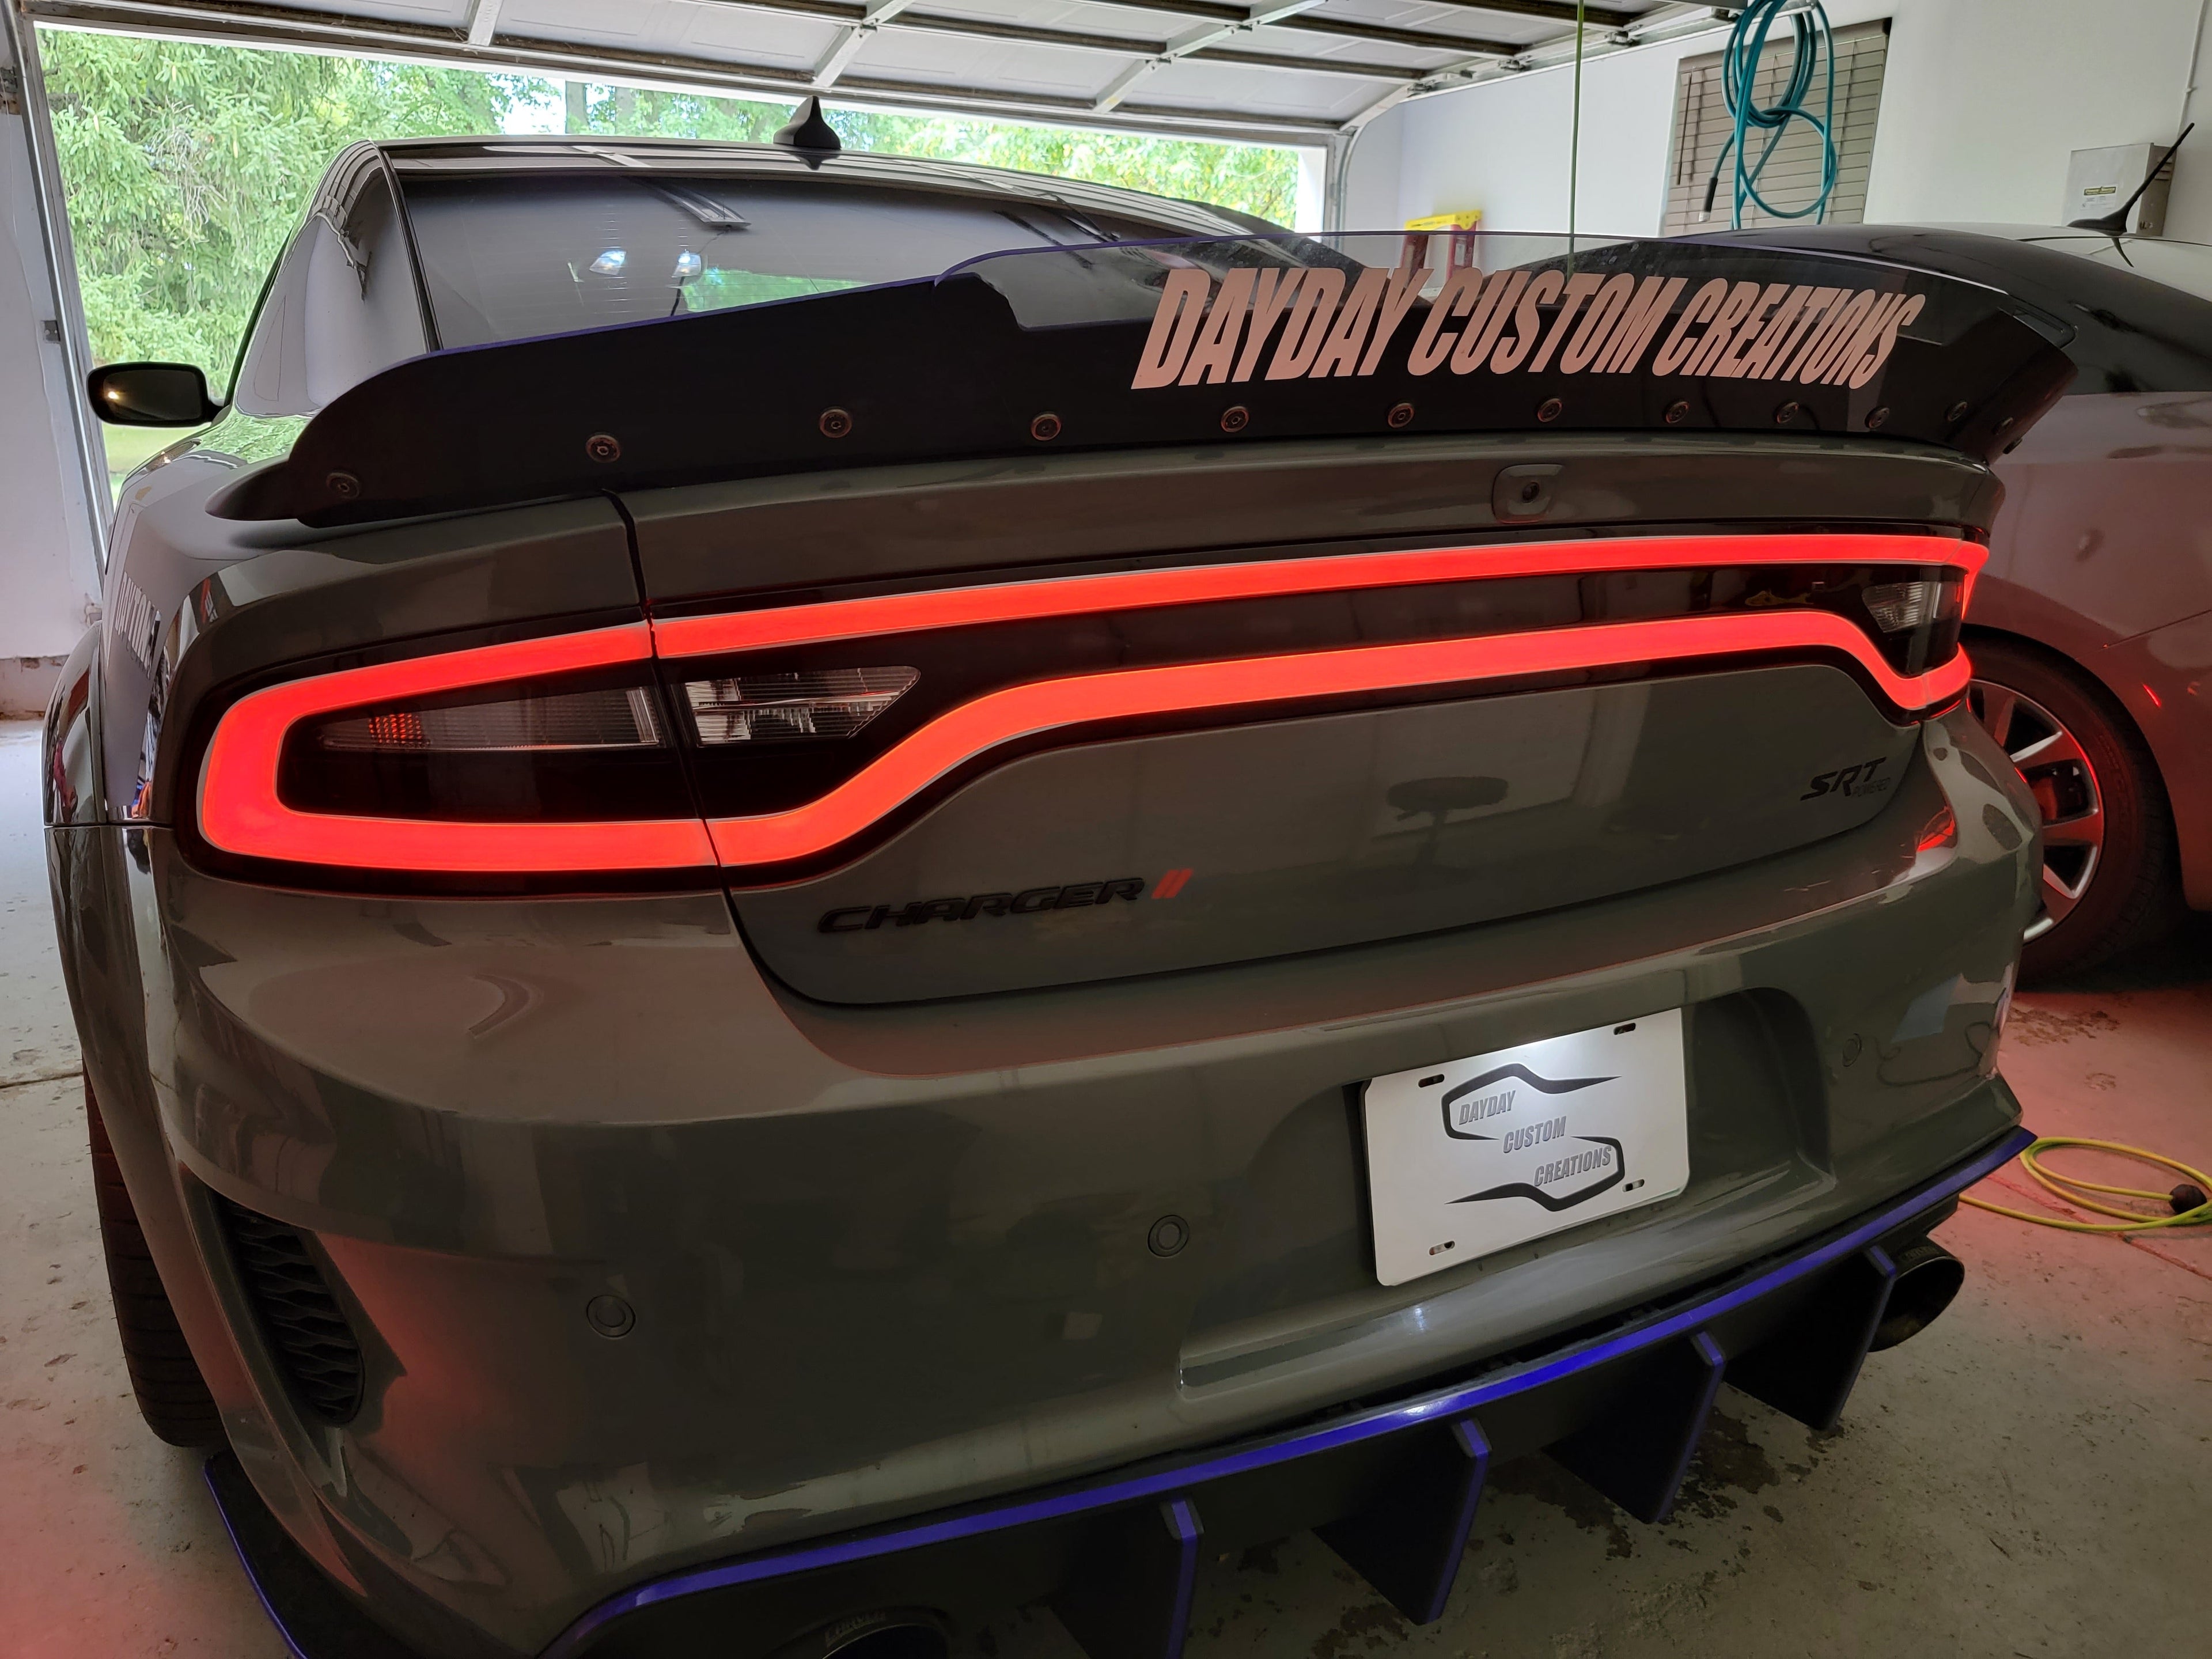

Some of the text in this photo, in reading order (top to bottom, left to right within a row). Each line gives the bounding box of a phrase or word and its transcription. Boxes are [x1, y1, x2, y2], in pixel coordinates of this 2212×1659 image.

[1131, 266, 1926, 389] DAYDAY CUSTOM CREATIONS
[1800, 756, 1887, 801] SRT
[817, 877, 1145, 933] CHARGER
[1458, 1090, 1516, 1126] DAYDAY
[1502, 1115, 1567, 1154] CUSTOM
[1533, 1146, 1612, 1187] CREATIONS
